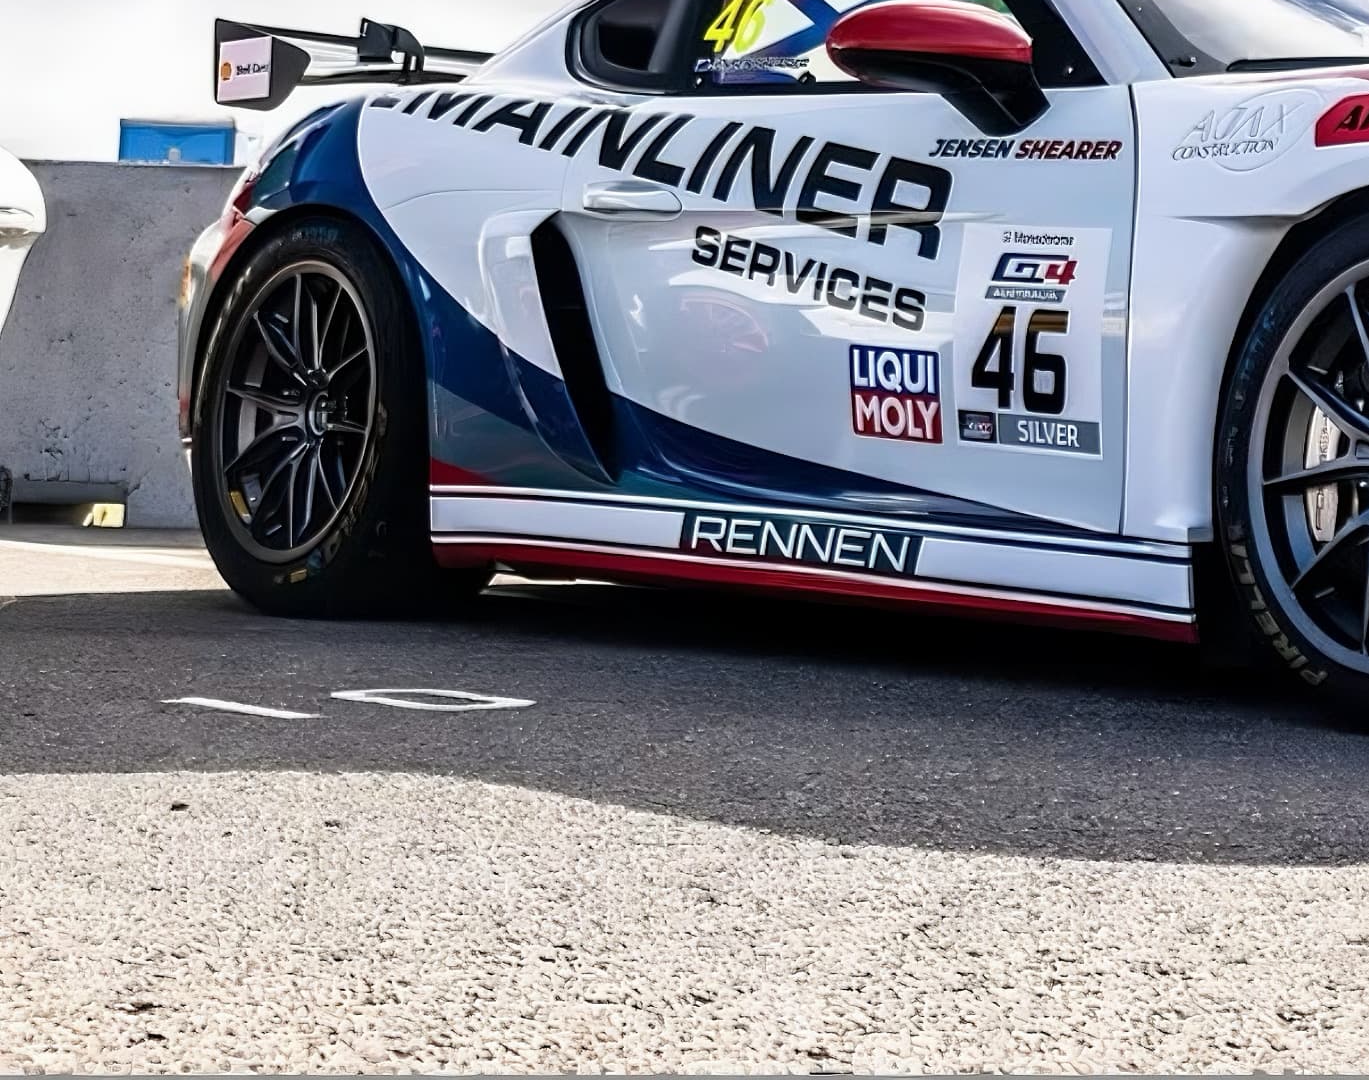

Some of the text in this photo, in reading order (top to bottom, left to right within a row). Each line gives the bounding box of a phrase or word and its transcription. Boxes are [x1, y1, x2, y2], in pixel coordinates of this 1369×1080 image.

[402, 90, 952, 260] MAINLINER
[929, 138, 1123, 160] JENSEN SHEARER
[692, 225, 927, 332] SERVICES
[852, 348, 936, 393] LIQUI
[971, 306, 1070, 415] 46
[854, 394, 940, 440] MOLY
[1017, 419, 1081, 448] SILVER
[691, 515, 911, 573] RENNEN
